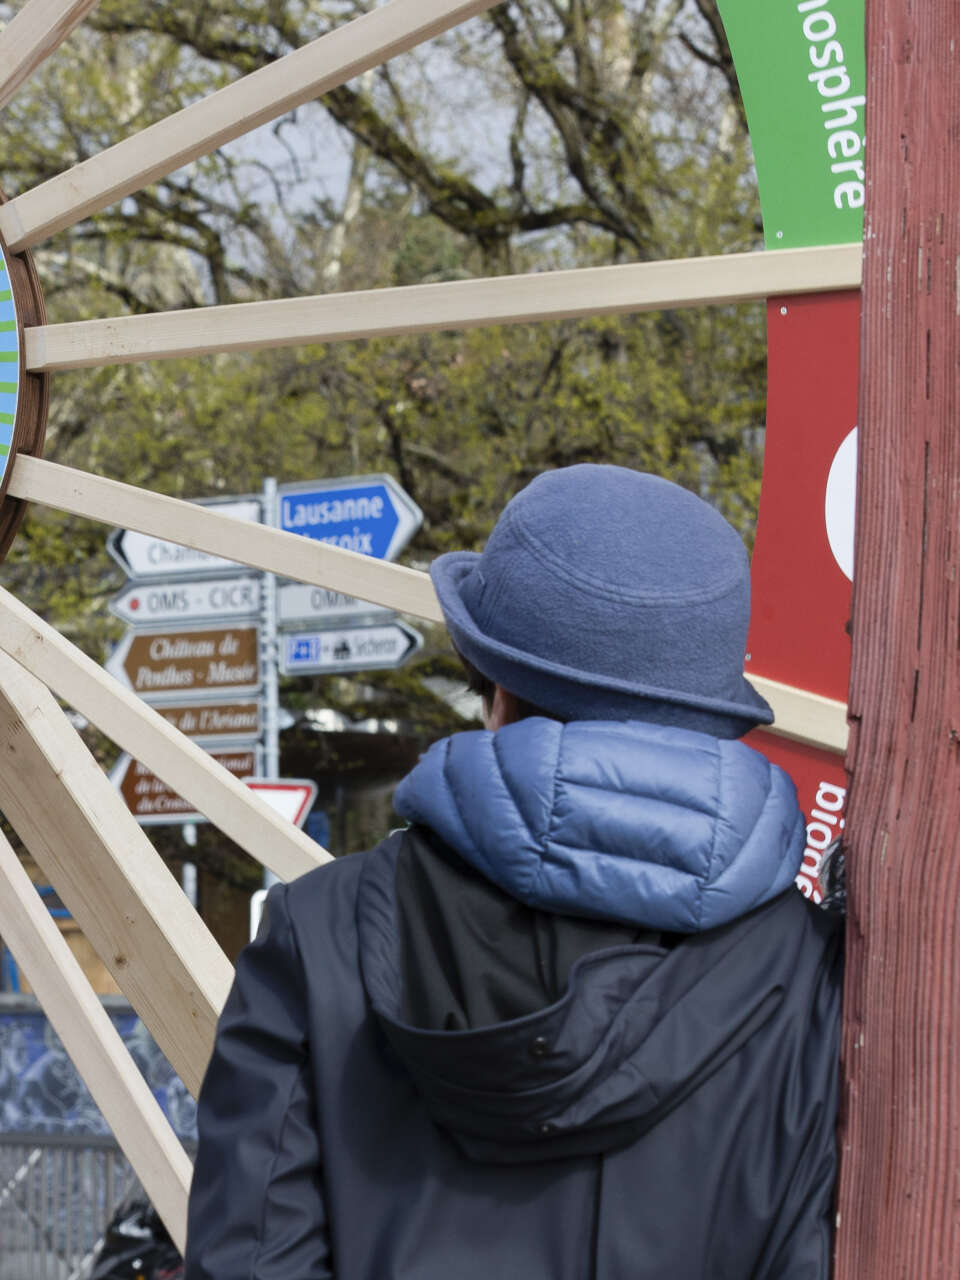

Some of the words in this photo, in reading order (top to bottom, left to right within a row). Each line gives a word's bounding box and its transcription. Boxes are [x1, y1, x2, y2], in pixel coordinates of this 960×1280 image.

[283, 495, 383, 528] Lausanne
[147, 590, 189, 612] OMS
[209, 584, 254, 609] CICR
